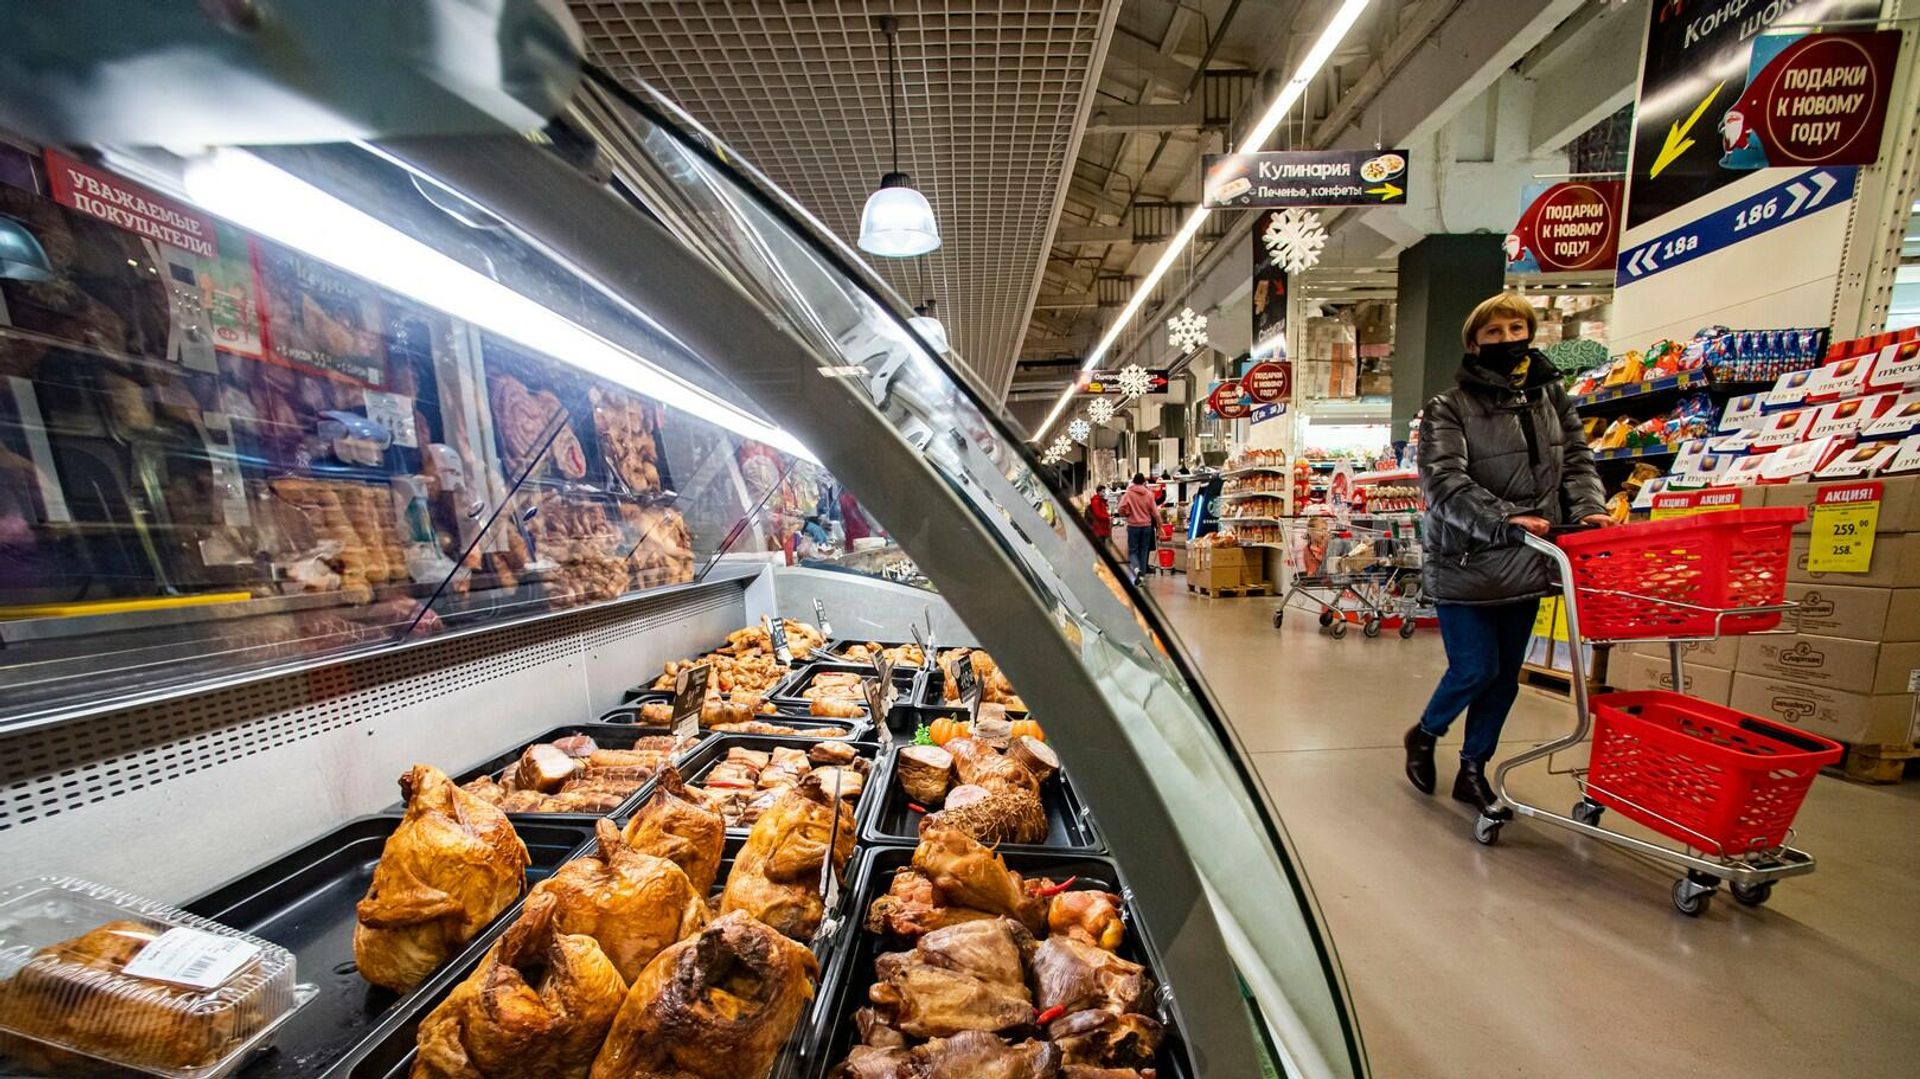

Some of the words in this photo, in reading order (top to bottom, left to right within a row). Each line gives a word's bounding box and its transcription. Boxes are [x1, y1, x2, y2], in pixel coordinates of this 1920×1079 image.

[1784, 66, 1868, 92] ПОДАРКИ
[1776, 97, 1790, 117] К
[1791, 94, 1865, 116] НОВОМУ
[1791, 121, 1841, 146] ГОДУ!
[1258, 161, 1351, 180] Кулинария
[1258, 185, 1311, 198] Печенье,
[1311, 185, 1362, 197] конфеты
[67, 168, 203, 236] УВАЖАЕМЫЕ
[1545, 203, 1604, 222] ПОДАРКИ
[72, 191, 213, 257] ПОКУПАТЕЛИ!
[1542, 224, 1552, 238] К
[1553, 222, 1604, 237] НОВОМУ
[1554, 240, 1590, 257] ГОДУ!
[1663, 235, 1699, 260] 18а
[1819, 376, 1858, 391] merci
[1816, 418, 1862, 433] merci
[1762, 429, 1800, 441] merci
[1658, 498, 1689, 509] АКЦИЯ!
[1700, 493, 1736, 506] АКЦИЯ!
[1824, 488, 1873, 503] АКЦИЯ!
